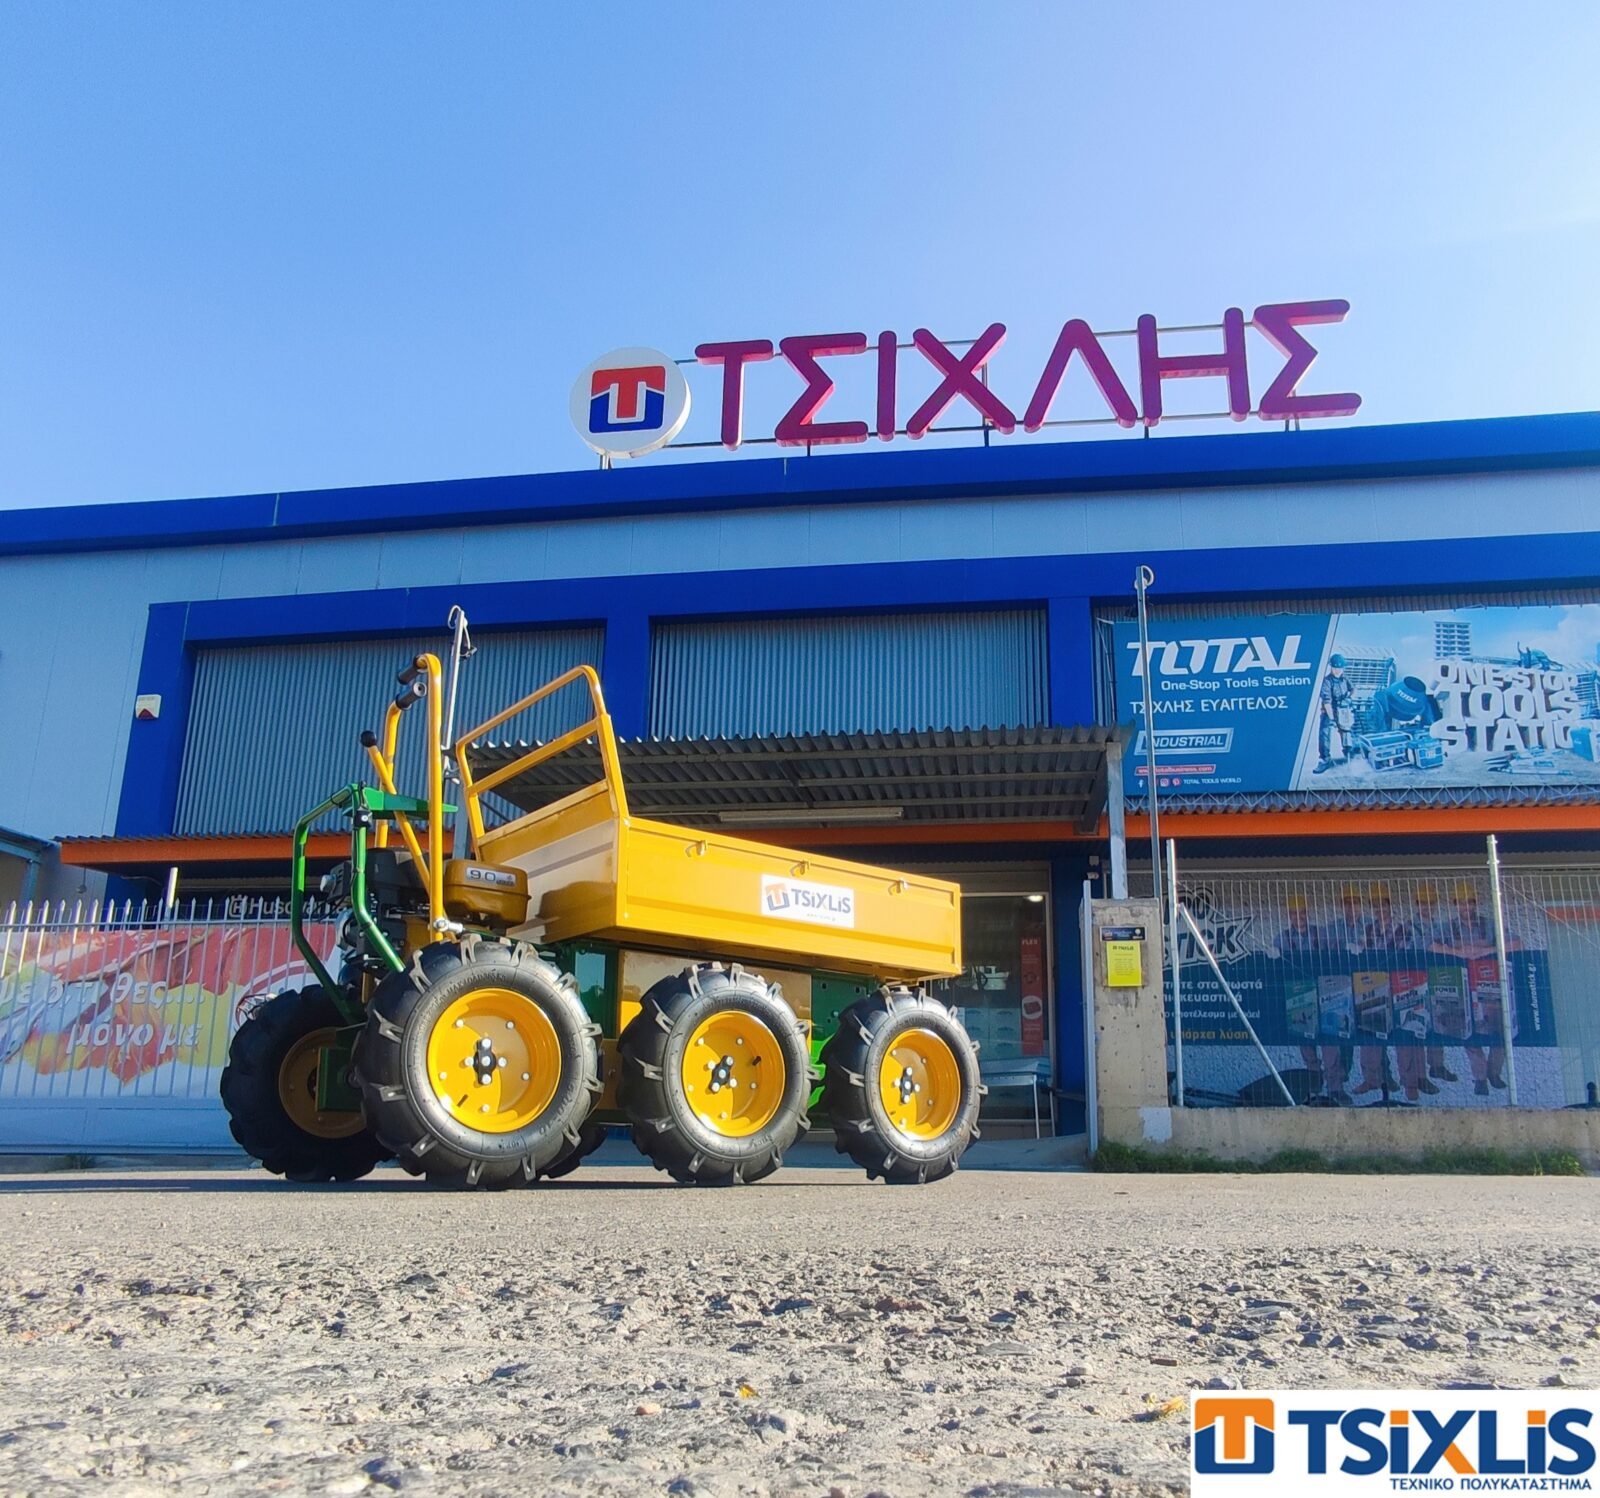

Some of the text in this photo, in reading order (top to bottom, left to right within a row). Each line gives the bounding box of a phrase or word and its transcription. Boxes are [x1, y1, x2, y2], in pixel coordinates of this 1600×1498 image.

[694, 299, 1362, 450] ΤΣΙΧΛΗΣ
[1126, 635, 1311, 677] TOTAL
[1161, 675, 1311, 692] One-Stop Tools Station
[1437, 660, 1578, 692] ONE-STOP
[1129, 696, 1288, 714] ΤΣΧΛΗΣ ΕΥΑΓΓΕΛΟΣ
[1436, 685, 1582, 722] TOOLS
[1144, 735, 1224, 748] NDUSTRIAL
[1430, 718, 1590, 753] STATIO
[1197, 981, 1219, 990] στα
[1225, 978, 1263, 990] ωστά
